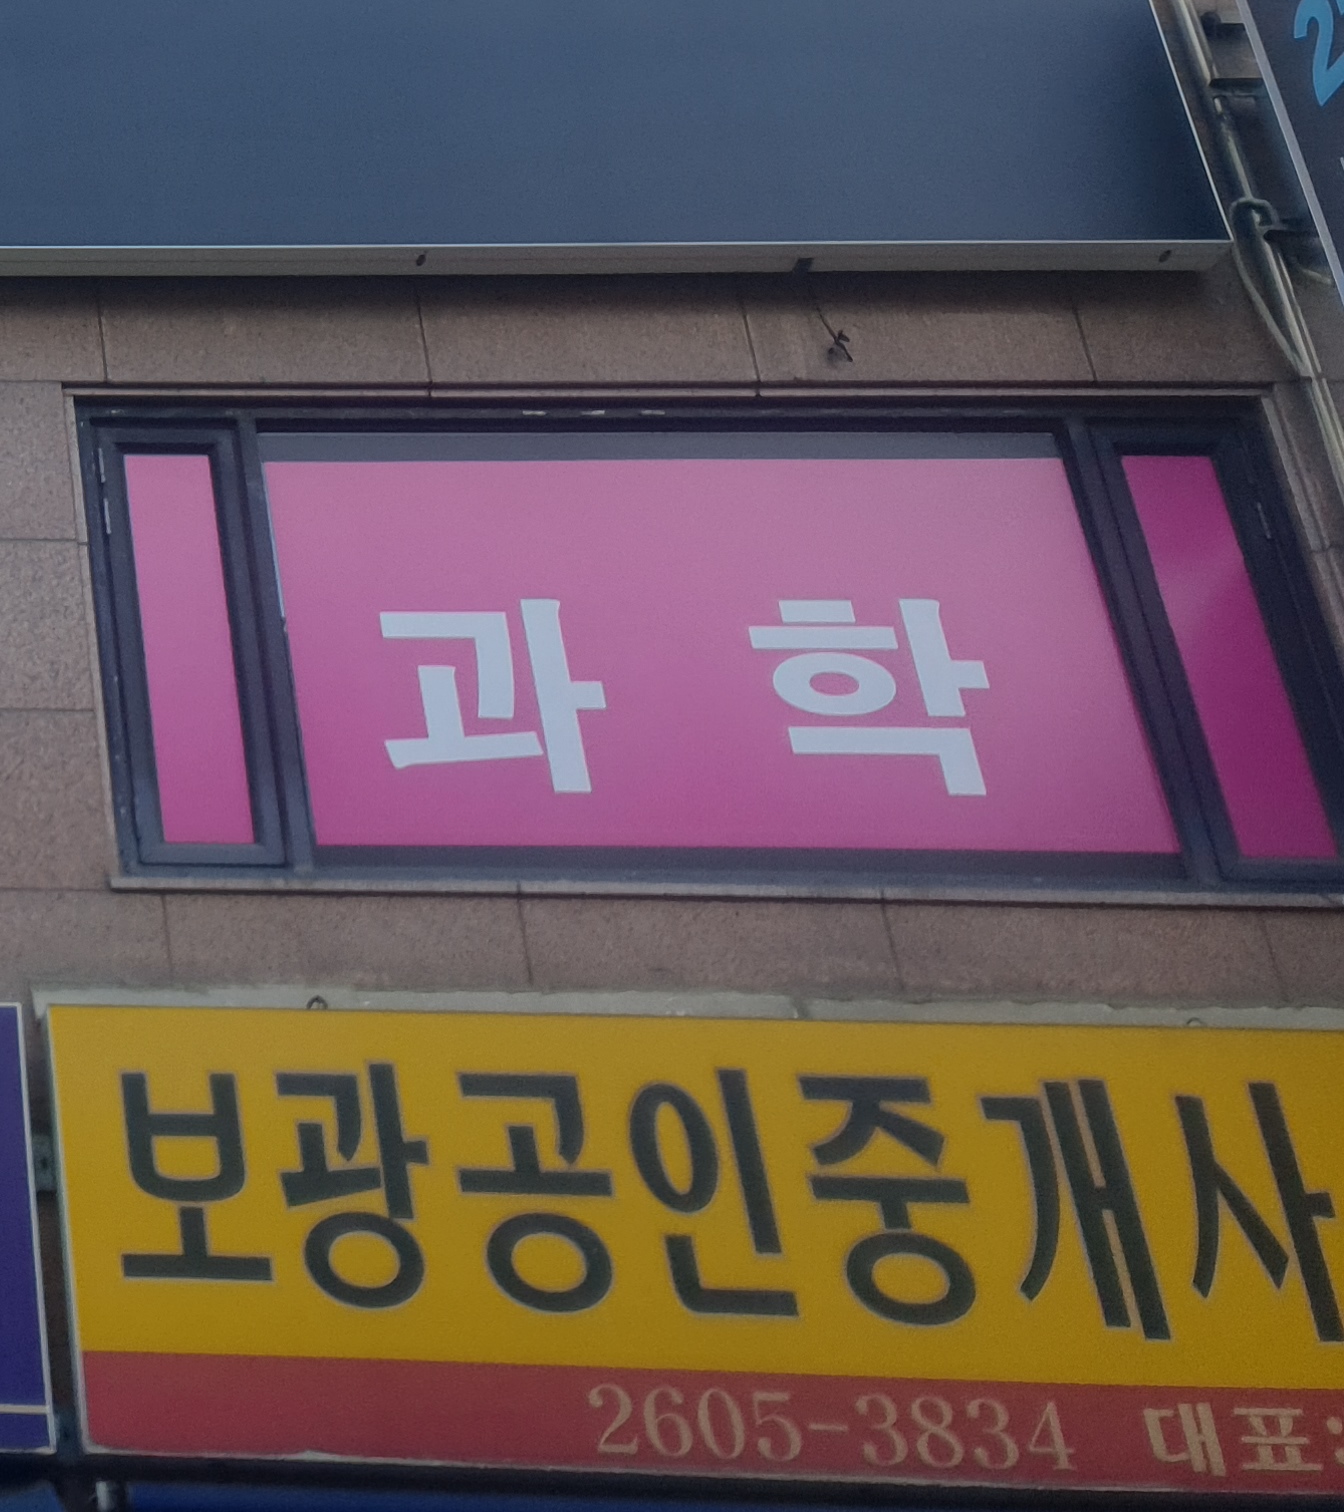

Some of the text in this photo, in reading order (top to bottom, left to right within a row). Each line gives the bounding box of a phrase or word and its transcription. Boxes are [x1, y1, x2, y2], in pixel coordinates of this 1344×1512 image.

[378, 598, 991, 796] 과학
[120, 1062, 1344, 1343] 보광공인중개사
[588, 1383, 1077, 1472] 2605-3834
